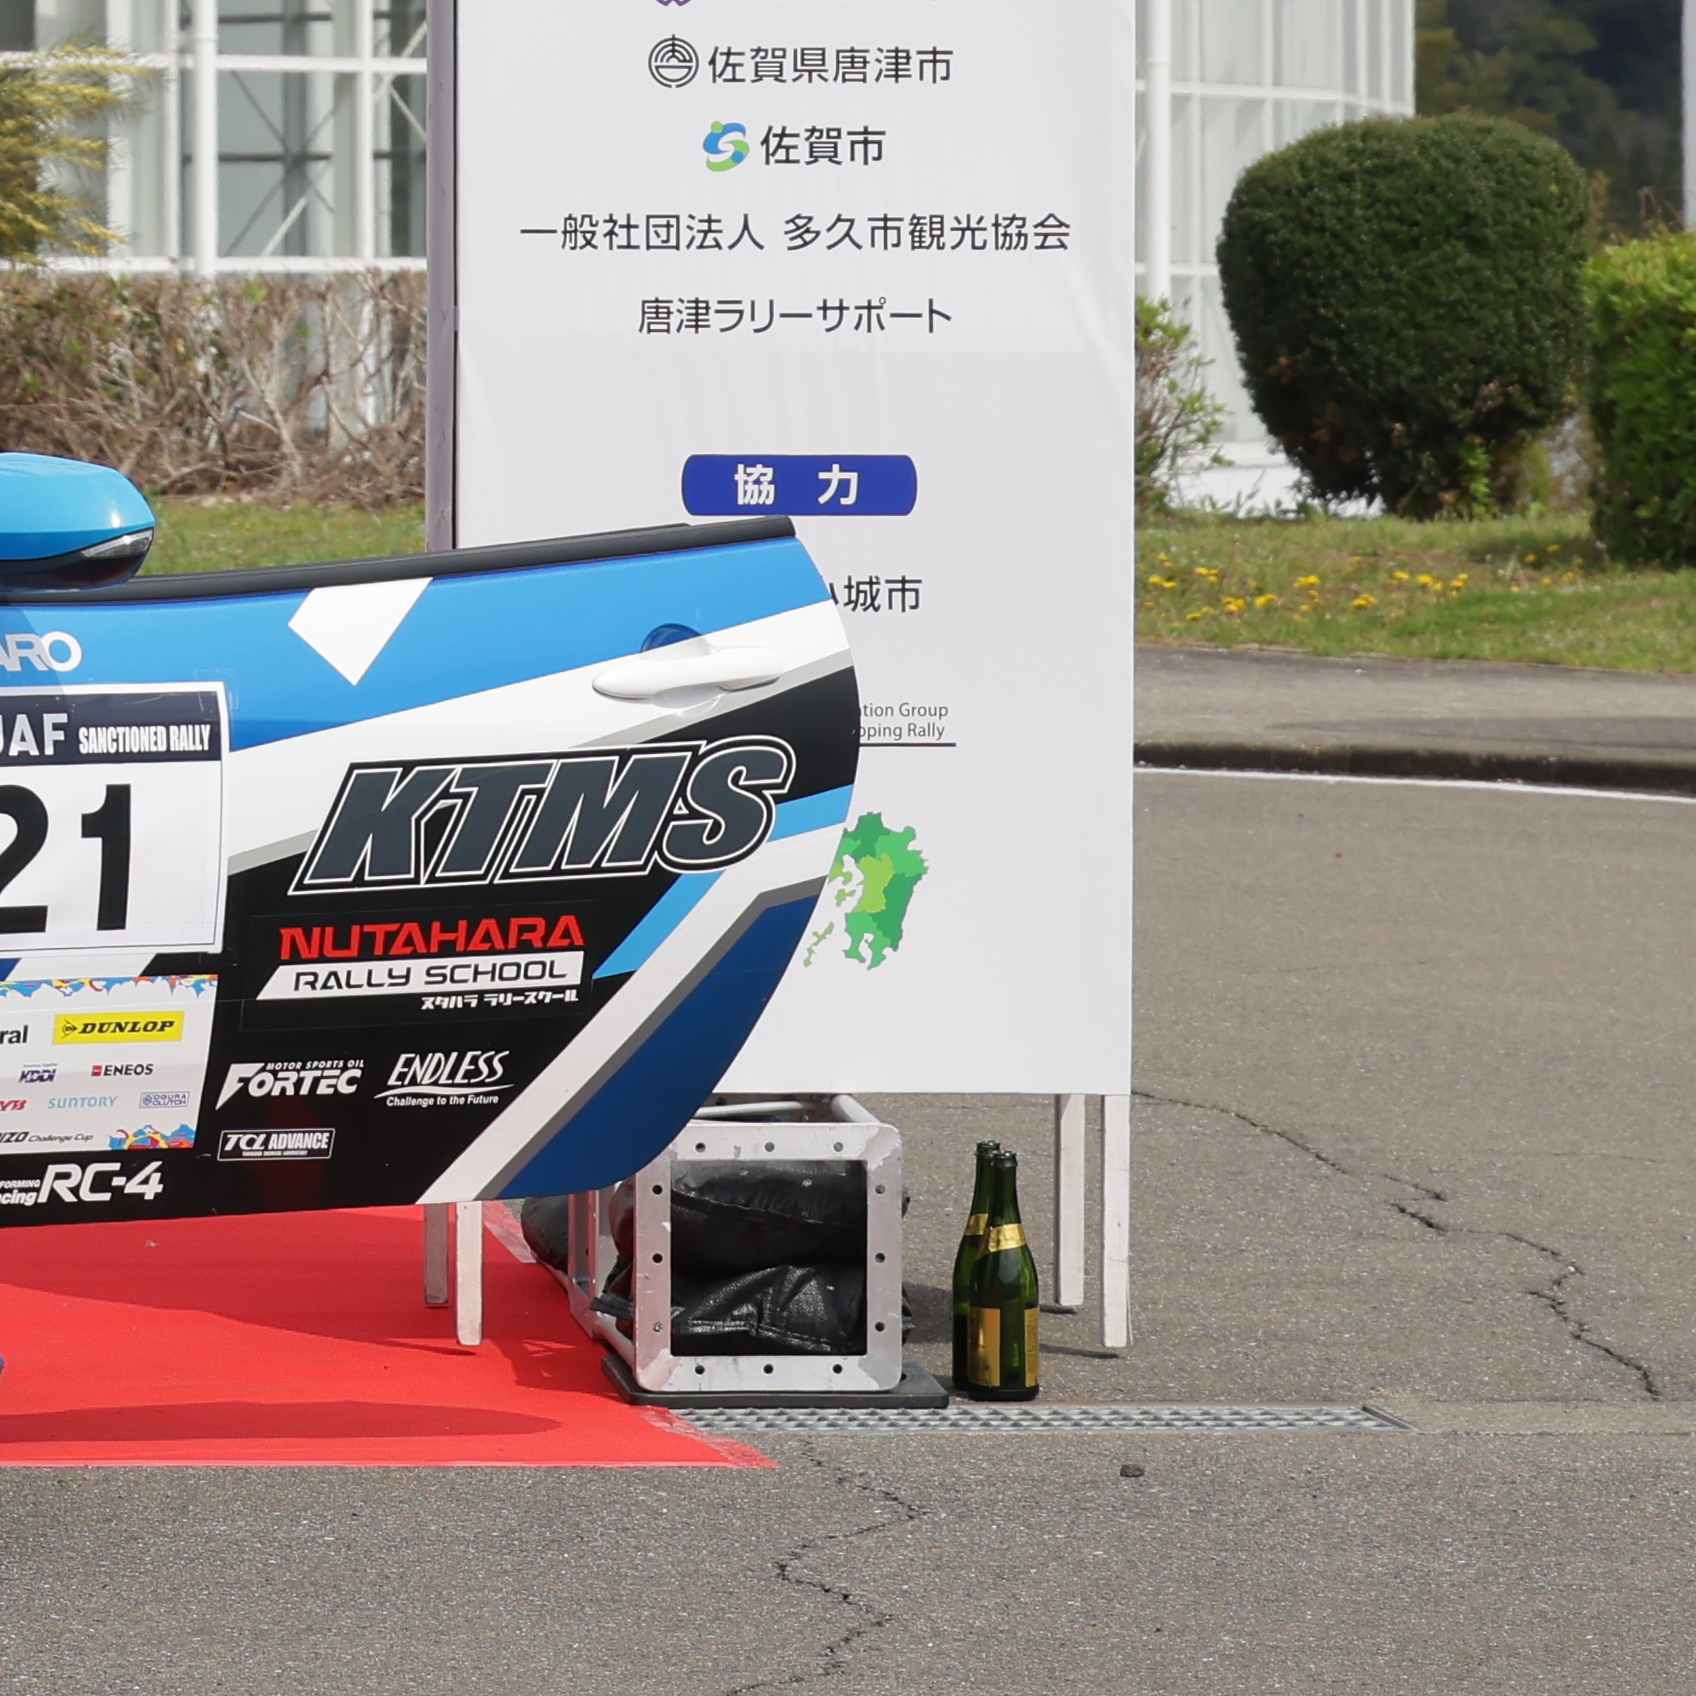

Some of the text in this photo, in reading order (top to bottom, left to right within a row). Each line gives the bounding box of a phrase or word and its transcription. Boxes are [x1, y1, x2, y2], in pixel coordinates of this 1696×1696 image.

[708, 45, 954, 84] 佐賀県唐津市
[759, 126, 887, 166] 佐賀市
[519, 212, 1072, 252] 一般社団法人 多久市観光協会
[637, 297, 952, 334] 唐津ラリーサポート
[734, 463, 859, 507] 協力
[898, 702, 949, 720] Group
[78, 724, 167, 755] SANCTIONED
[169, 723, 210, 752] RALLY
[907, 722, 945, 741] Rally
[292, 738, 793, 892] KTMS
[279, 915, 585, 960] NUTAHARA
[294, 959, 568, 991] RALLY SCHOOL
[78, 1020, 175, 1035] DUNLOP
[18, 1068, 57, 1083] KDDI
[103, 1063, 154, 1077] ENEOS
[266, 1058, 365, 1071] MOTOR SPORTS OIL
[386, 1050, 511, 1087] ENDLESS
[217, 1062, 362, 1106] FORTEC
[386, 1093, 499, 1108] Challenge the Future
[28, 1133, 94, 1144] Challenge Cup
[224, 1132, 330, 1151] TCL ADVANCE
[37, 1160, 164, 1204] RC-4
